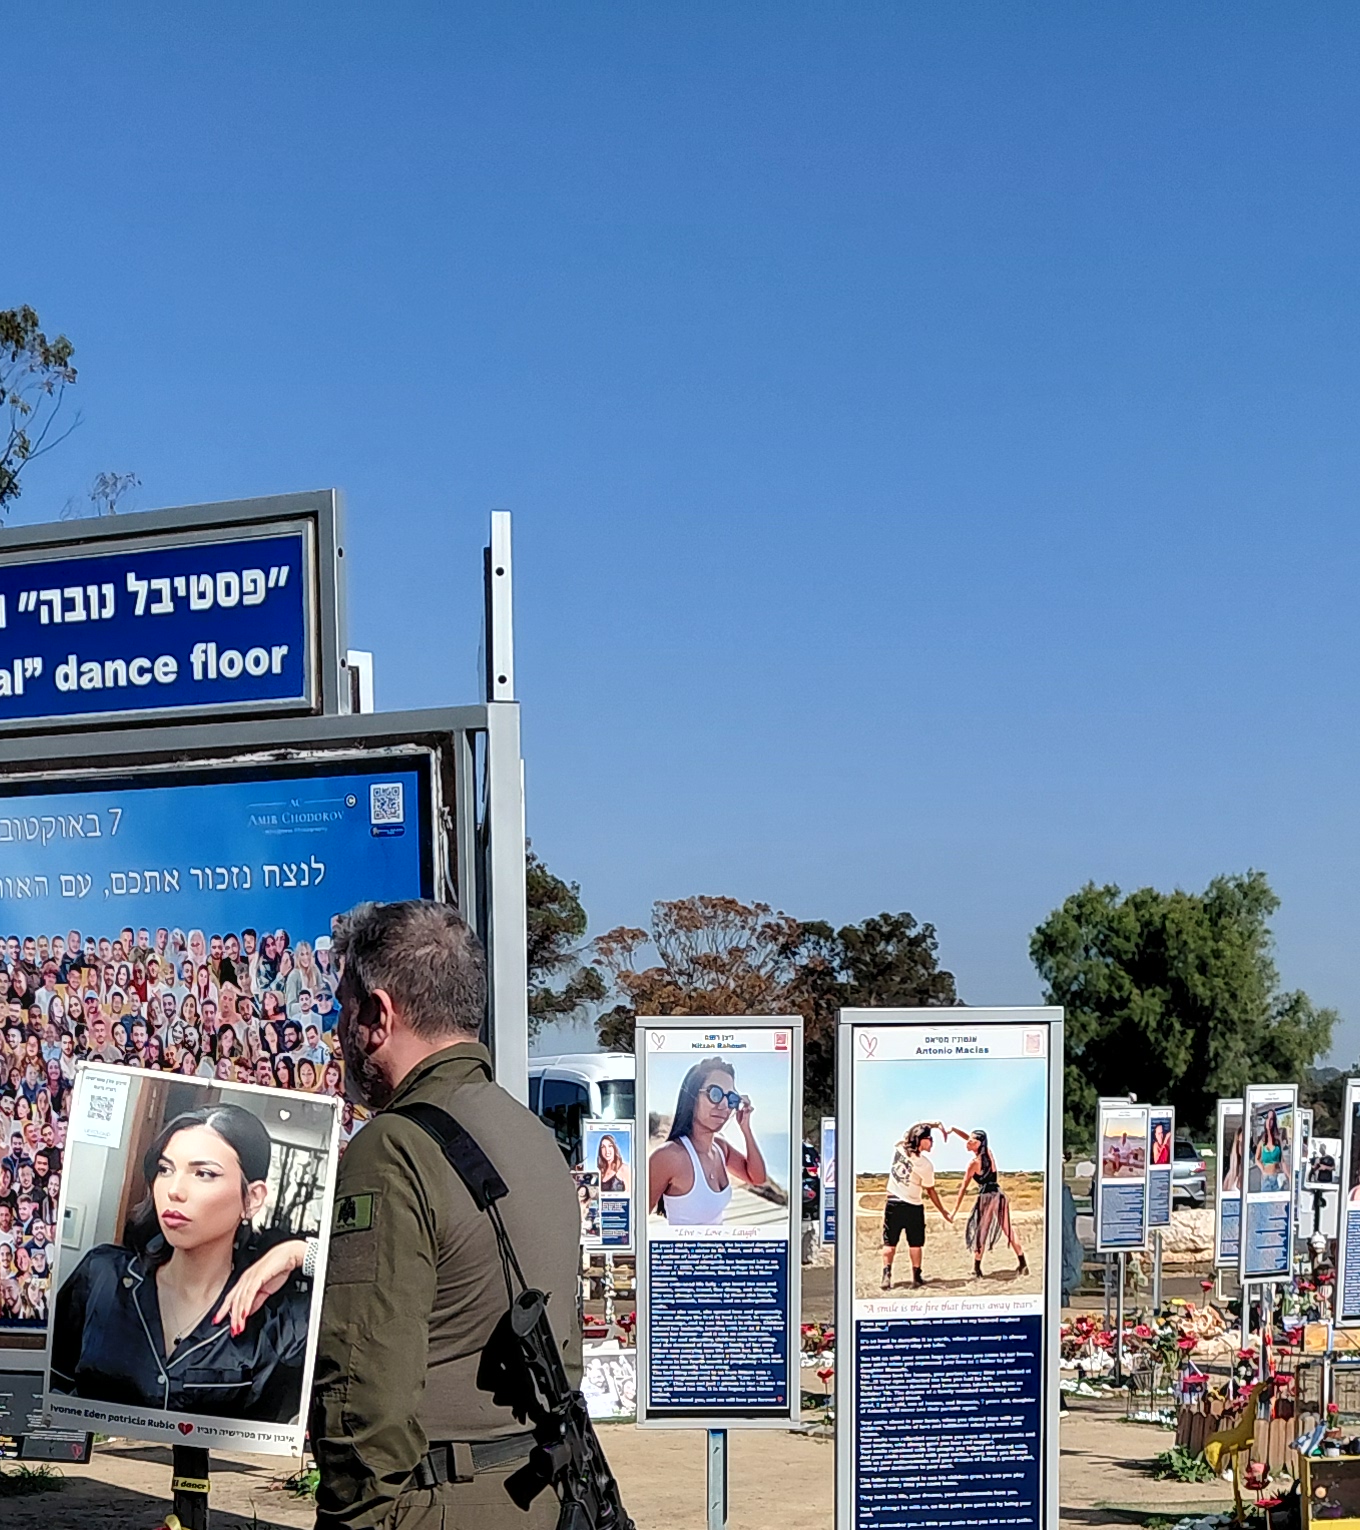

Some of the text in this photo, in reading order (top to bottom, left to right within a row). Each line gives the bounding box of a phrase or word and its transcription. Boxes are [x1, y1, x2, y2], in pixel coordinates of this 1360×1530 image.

[54, 654, 178, 691] dance
[190, 642, 289, 681] floor
[108, 807, 123, 836] 7
[102, 868, 181, 900] אתכם,
[189, 865, 252, 891] נזכור
[262, 854, 327, 888] לנצח
[59, 873, 92, 898] עם
[915, 1046, 990, 1055] Antonio Macias
[50, 1403, 175, 1430] Ivonne Eden patricia Rubio
